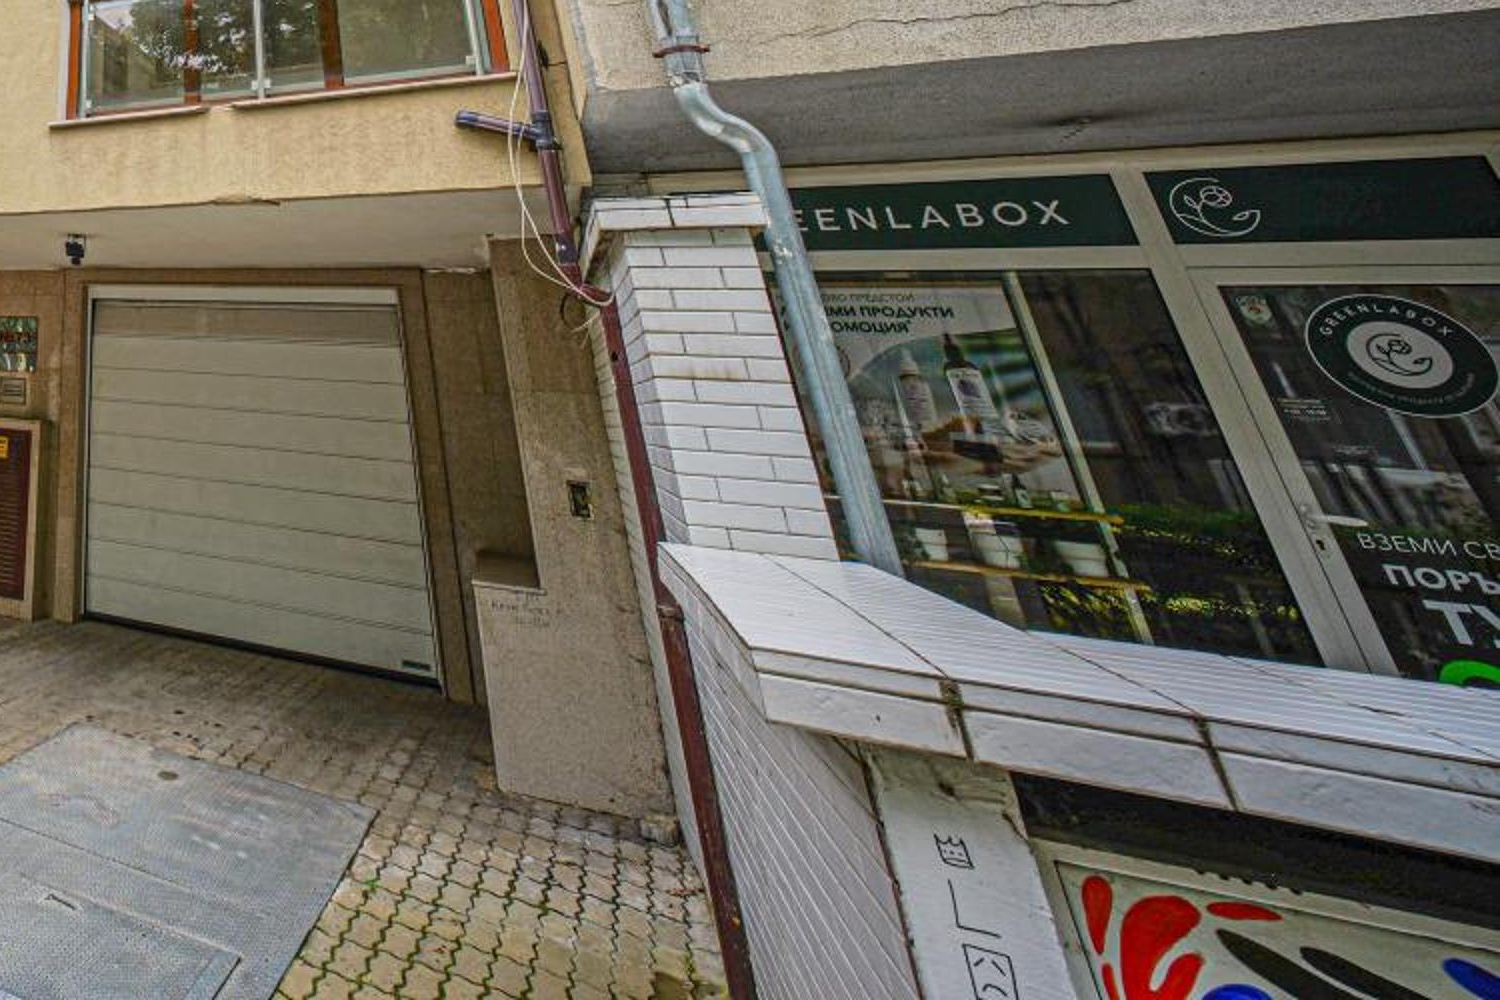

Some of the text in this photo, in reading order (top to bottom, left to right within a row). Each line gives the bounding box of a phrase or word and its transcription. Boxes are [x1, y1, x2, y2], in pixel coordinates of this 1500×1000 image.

[793, 200, 1070, 231] EENLABOX
[860, 305, 954, 319] ПРОДУКТИ
[1319, 304, 1453, 337] GREENLABOX
[1357, 532, 1458, 557] ВЗЕМИ
